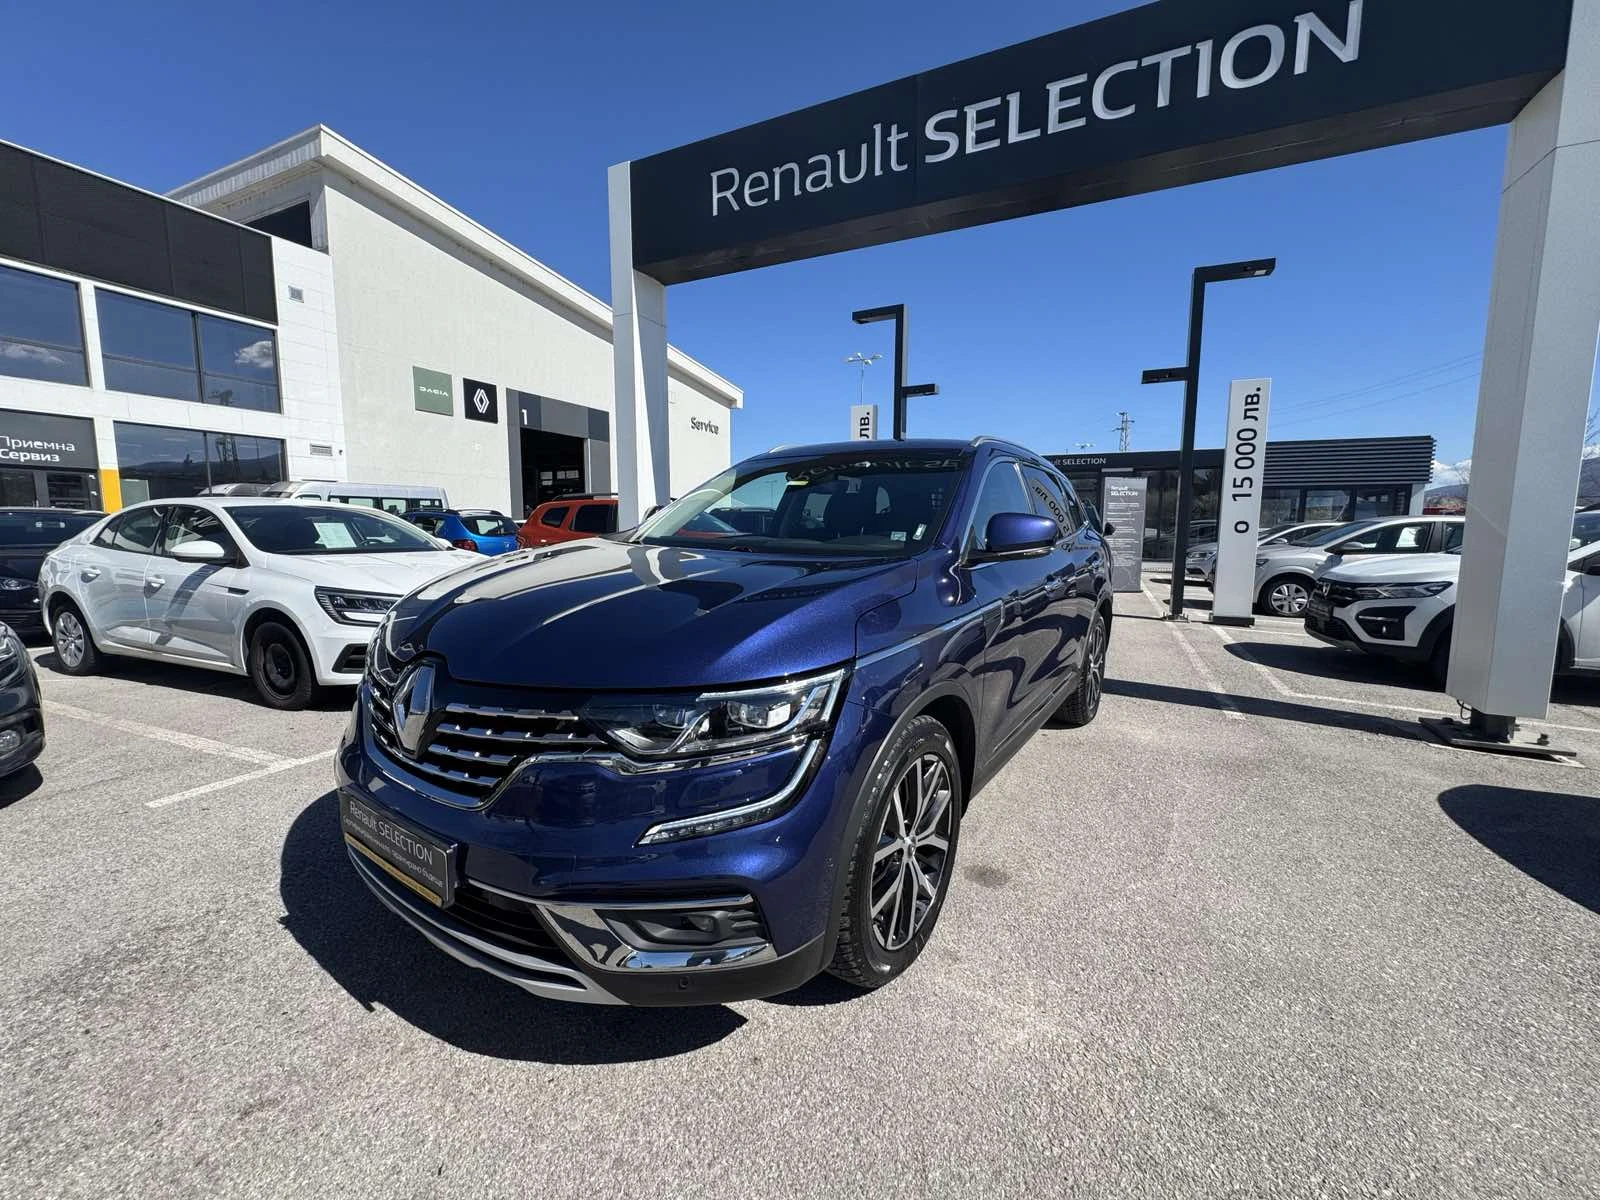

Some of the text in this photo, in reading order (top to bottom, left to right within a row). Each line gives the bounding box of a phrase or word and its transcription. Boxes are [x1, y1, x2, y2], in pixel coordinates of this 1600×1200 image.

[709, 0, 1364, 217] Renault SELECTION
[418, 386, 449, 397] DACIA
[1243, 387, 1261, 421] лв.
[521, 408, 528, 425] 1
[690, 416, 720, 435] Service
[0, 448, 60, 462] Сервиз
[1234, 428, 1258, 470] 000
[1062, 457, 1106, 466] SELECTION
[1232, 476, 1253, 502] 15
[349, 800, 378, 832] Renault
[378, 821, 433, 865] SELECTION
